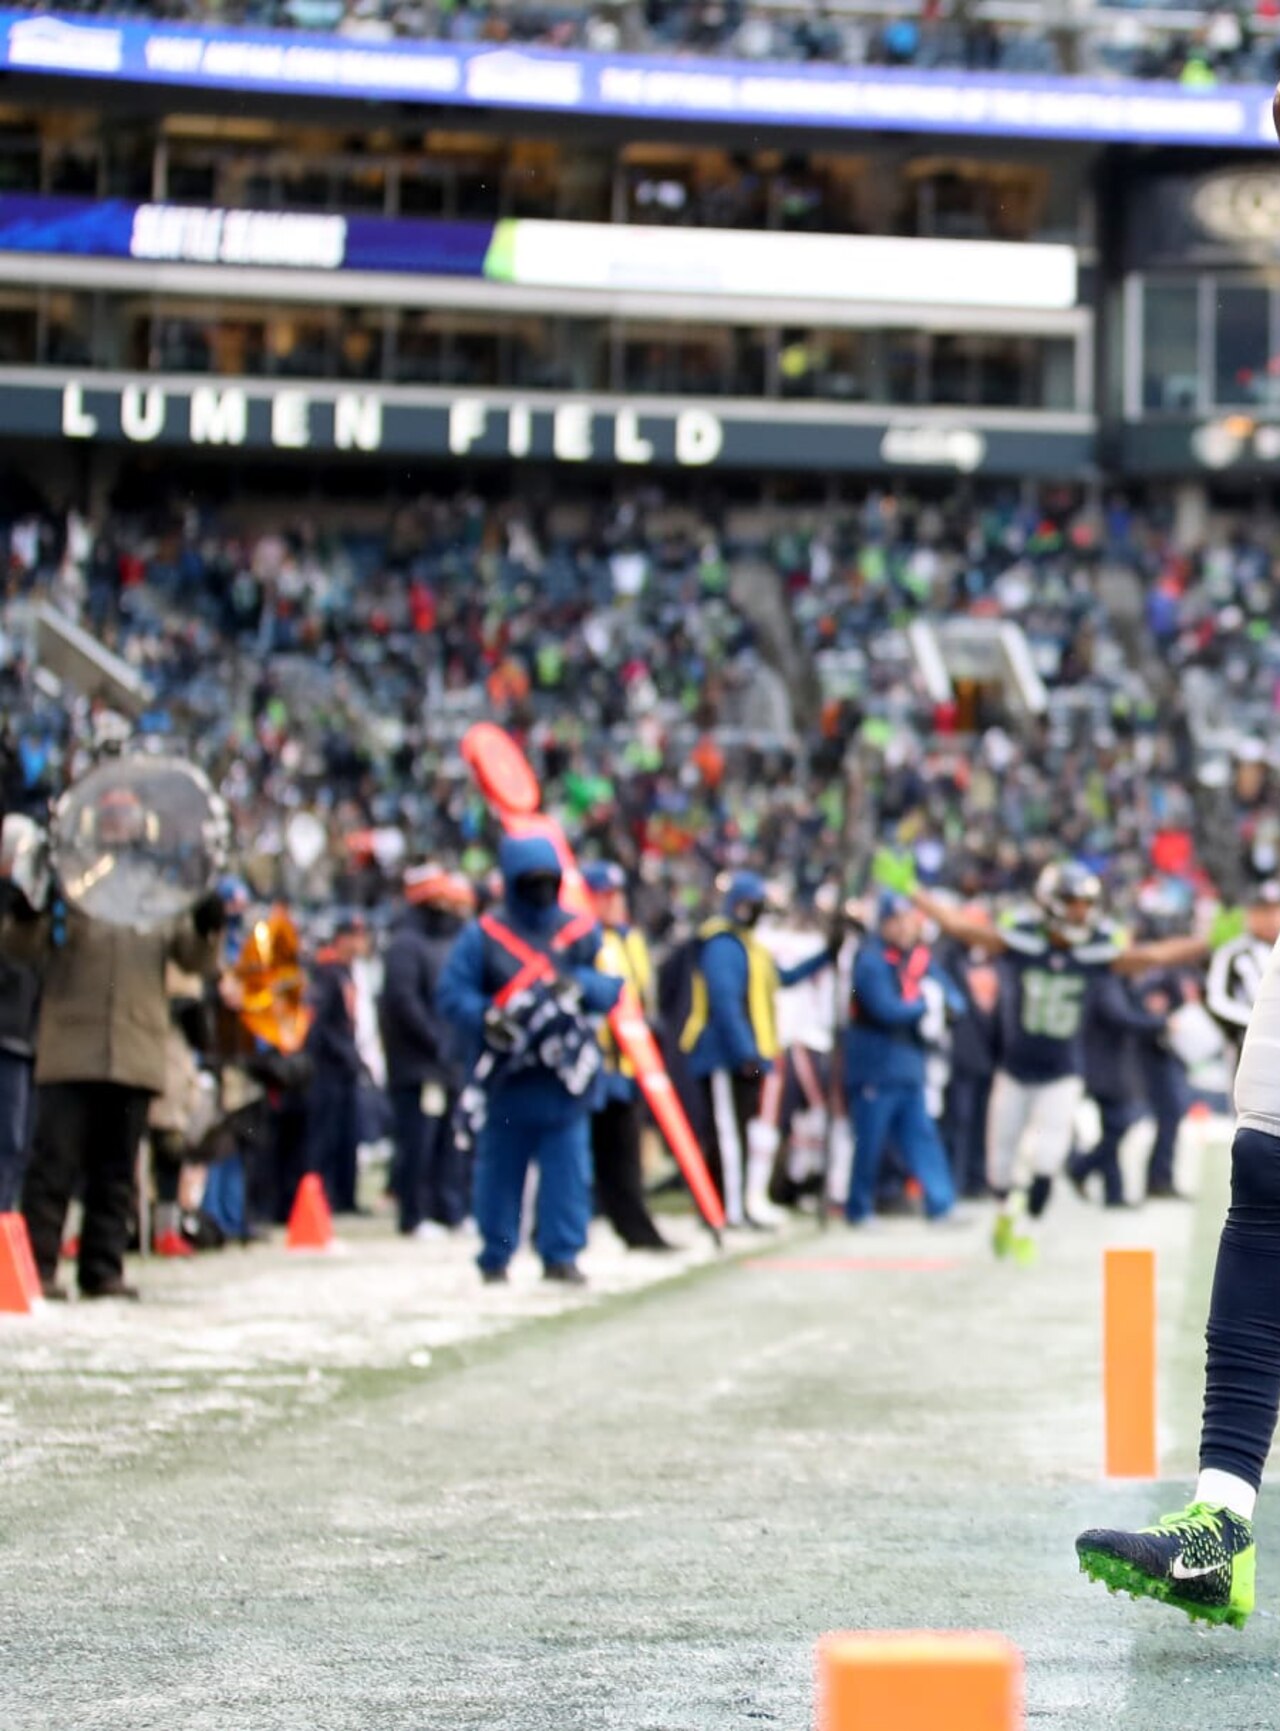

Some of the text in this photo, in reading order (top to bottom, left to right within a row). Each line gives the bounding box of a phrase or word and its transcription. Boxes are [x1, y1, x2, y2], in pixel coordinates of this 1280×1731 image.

[62, 381, 723, 465] LUMEN FIELD
[1023, 968, 1085, 1038] 16
